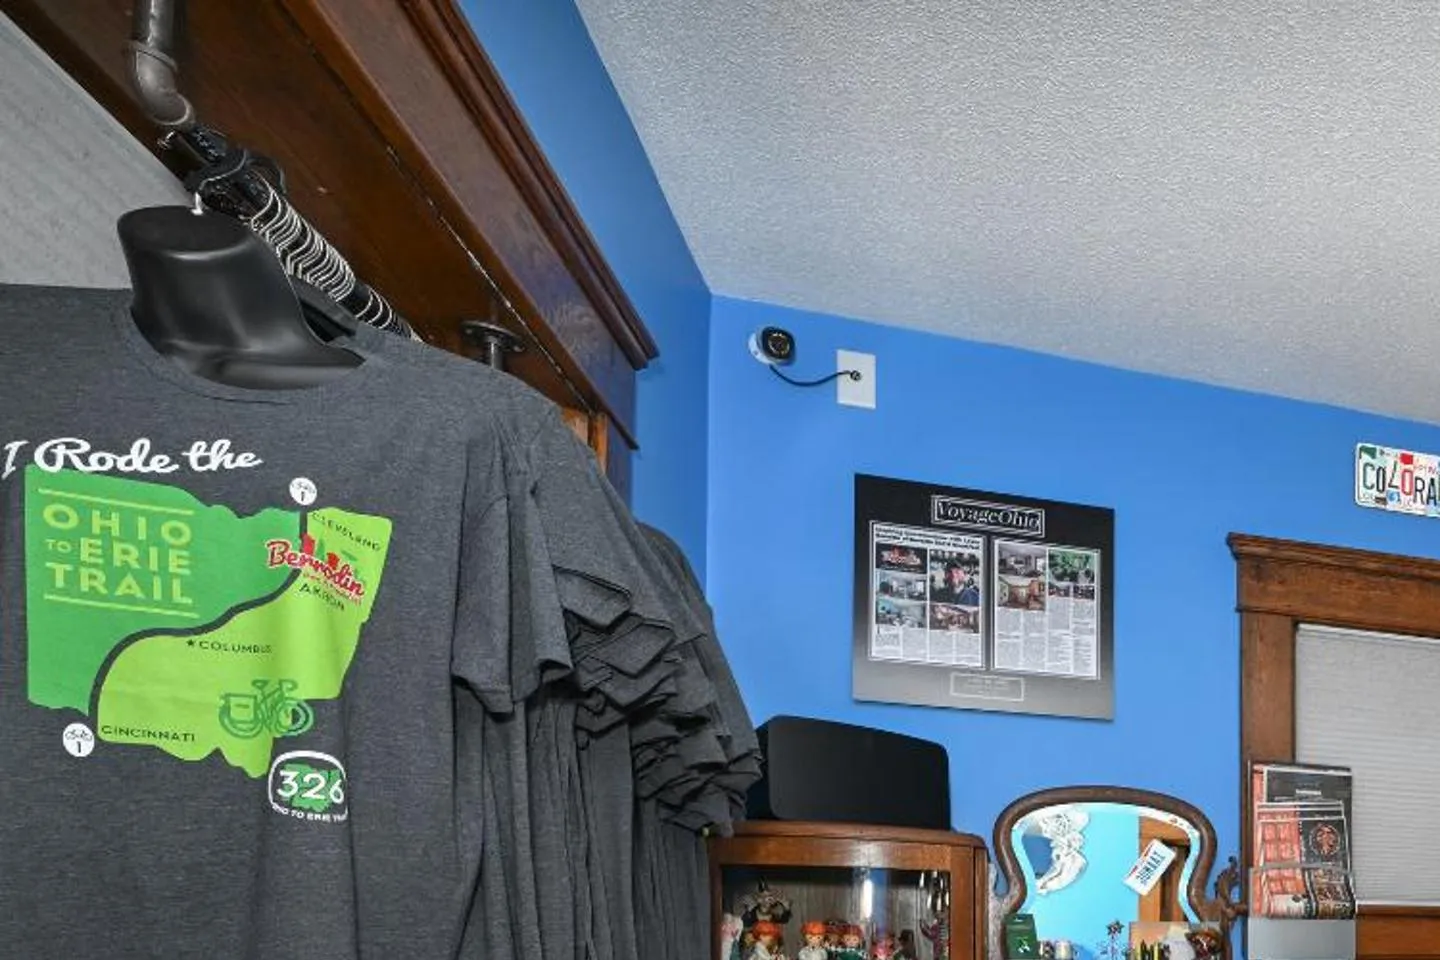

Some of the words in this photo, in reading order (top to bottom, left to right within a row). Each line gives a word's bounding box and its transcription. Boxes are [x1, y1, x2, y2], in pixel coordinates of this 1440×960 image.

[2, 440, 28, 480] I
[34, 437, 179, 474] Rode
[182, 438, 263, 472] the
[42, 503, 192, 546] OHIO
[312, 511, 381, 551] CLEVELAND
[935, 499, 1042, 530] VoyageOhio
[46, 539, 71, 553] TO
[80, 537, 191, 576] ERIE
[46, 562, 193, 604] TRAIL
[101, 725, 195, 743] CINCINNATI
[276, 770, 345, 805] 326
